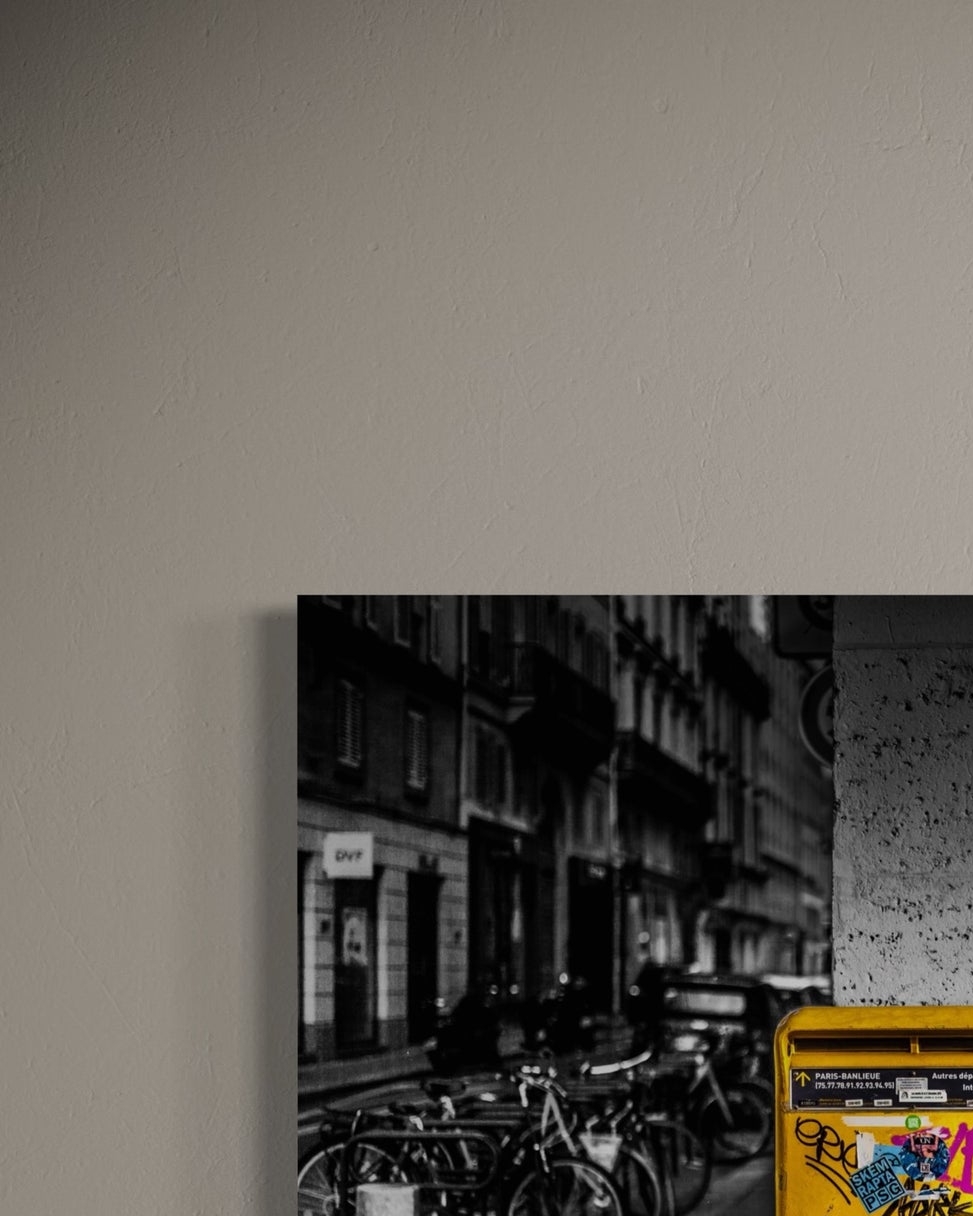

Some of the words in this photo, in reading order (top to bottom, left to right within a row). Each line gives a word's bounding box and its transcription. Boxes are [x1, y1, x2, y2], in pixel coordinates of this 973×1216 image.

[932, 1072, 957, 1080] Autres
[851, 1159, 890, 1186] SKEM
[857, 1170, 895, 1198] RAPTA
[866, 1181, 902, 1210] PSG
